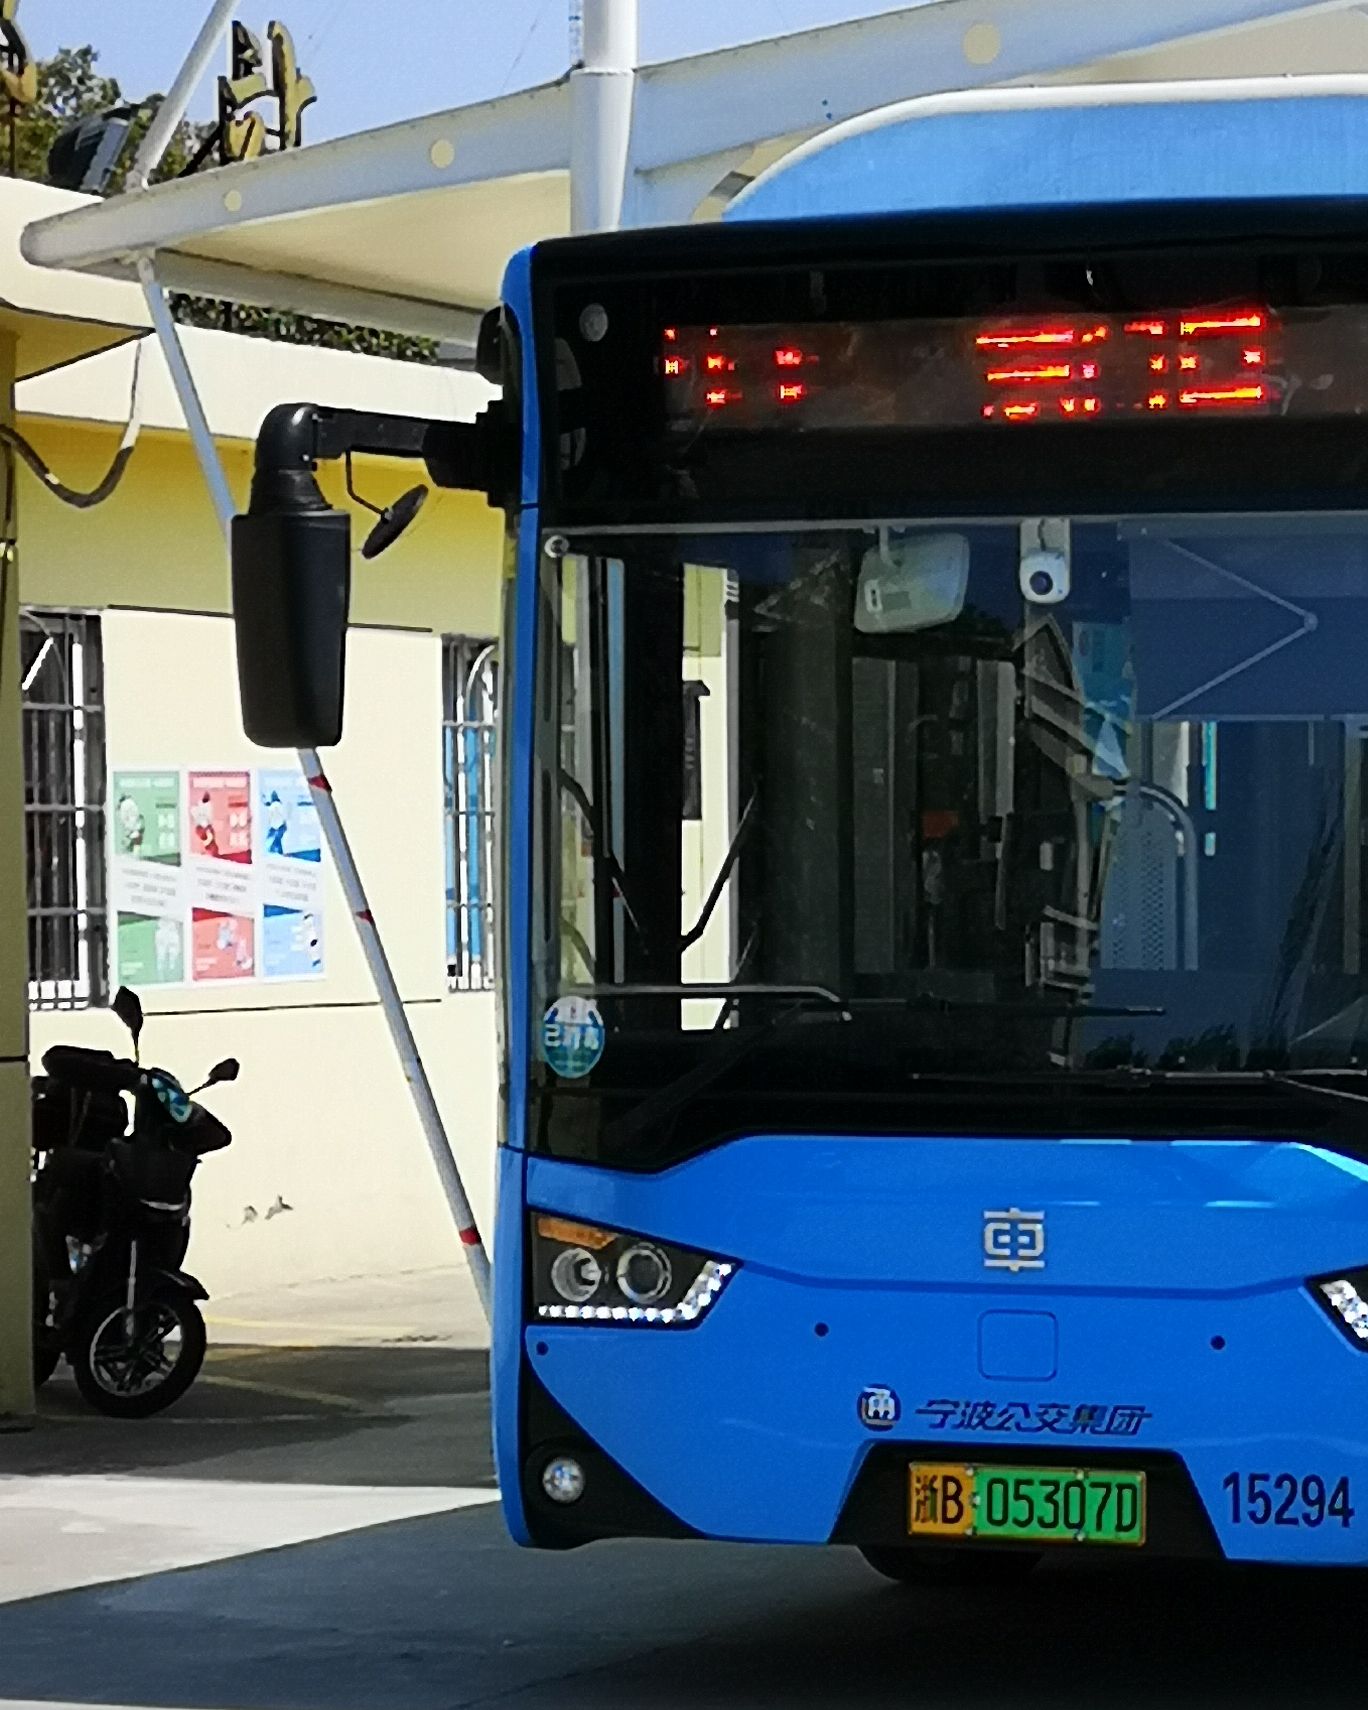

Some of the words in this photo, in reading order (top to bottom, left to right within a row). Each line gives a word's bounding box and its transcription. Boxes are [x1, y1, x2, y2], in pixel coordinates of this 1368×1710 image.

[915, 1398, 1153, 1436] 宁波公交集团
[1222, 1472, 1355, 1529] 15294
